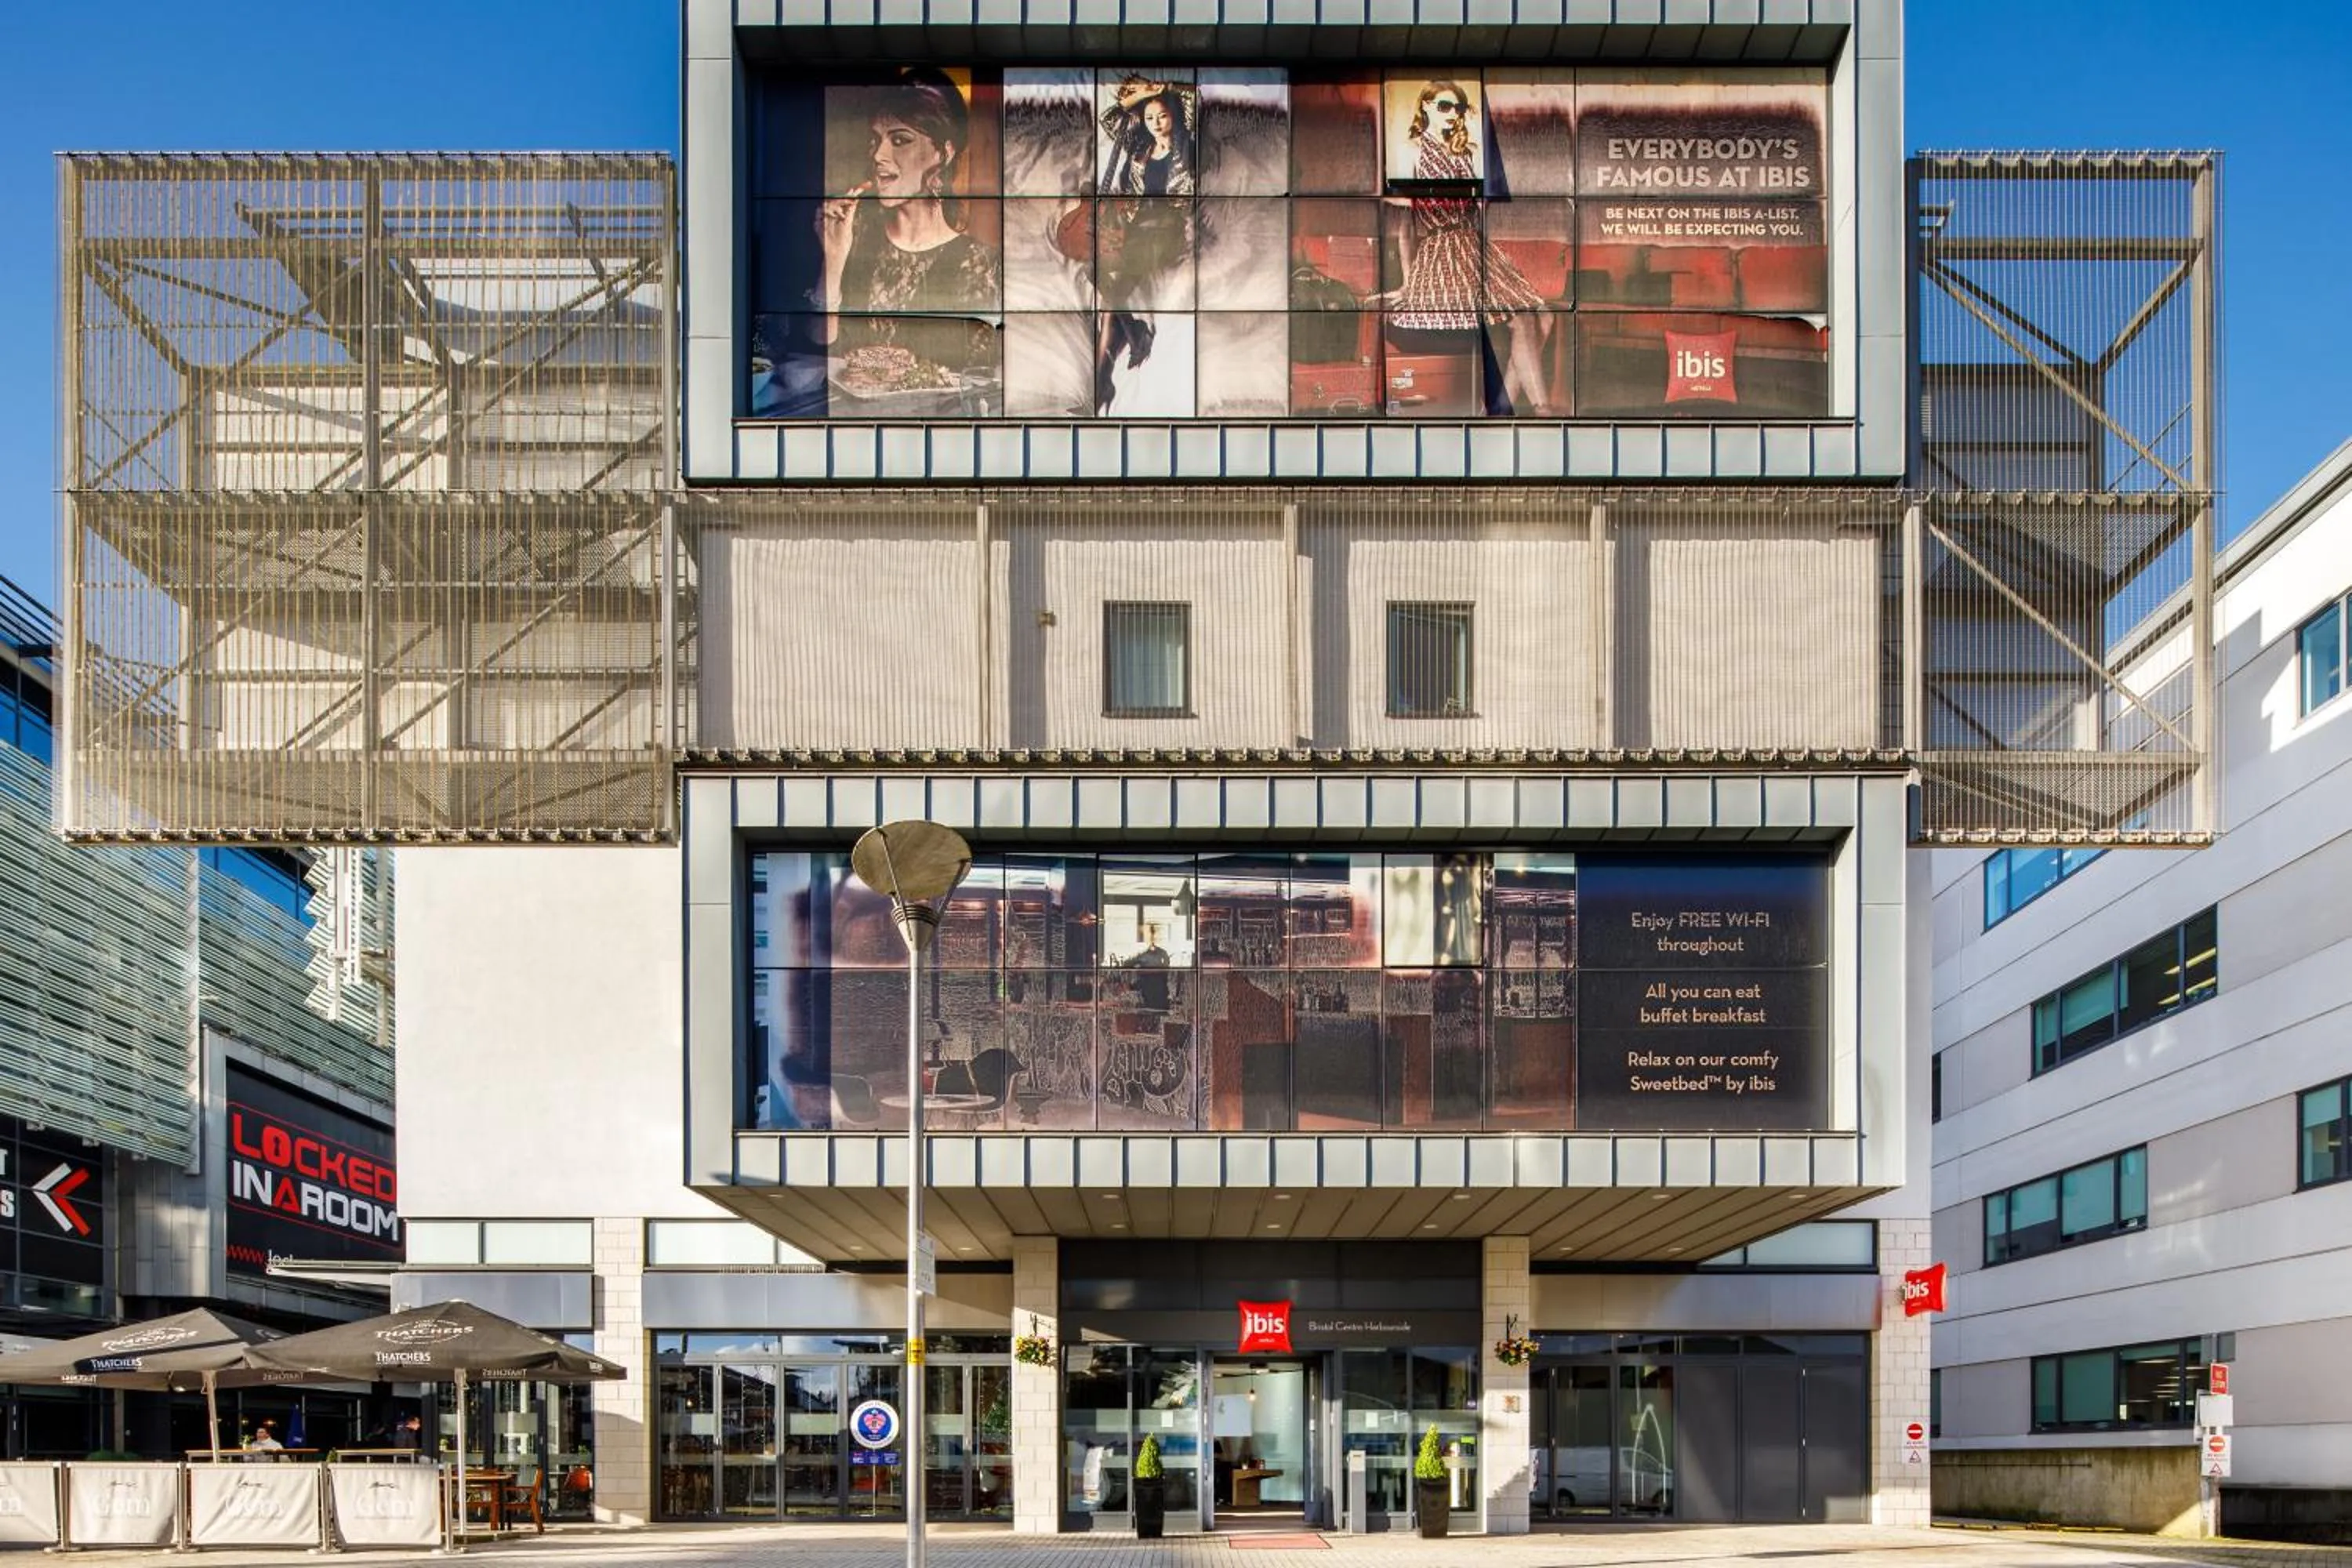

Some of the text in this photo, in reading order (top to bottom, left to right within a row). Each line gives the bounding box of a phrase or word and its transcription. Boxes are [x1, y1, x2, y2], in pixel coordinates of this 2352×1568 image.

[1608, 137, 1799, 159] EVERYBODY'S
[1596, 165, 1810, 188] FAMOUS AT IBIS
[1606, 208, 1799, 220] BE NEXT ON THE IBIS A-LIST.
[1601, 223, 1803, 236] WE WILL BE EXPECTING YOU.
[1676, 350, 1726, 378] ibis
[1631, 912, 1769, 931] Enjoy FREE WI-FI
[1657, 936, 1744, 956] throughout
[1646, 983, 1761, 1002] All you can eat
[1640, 1007, 1766, 1023] buffet breakfast
[1628, 1050, 1779, 1069] Relax on our comfy
[1726, 1074, 1745, 1094] by
[1749, 1075, 1776, 1091] ibis
[232, 1112, 397, 1203] LOCKED
[376, 1325, 474, 1338] THATCHERS
[1246, 1312, 1285, 1334] ibis
[90, 1358, 143, 1369] THATCHERS
[376, 1352, 430, 1363] THATCHERS
